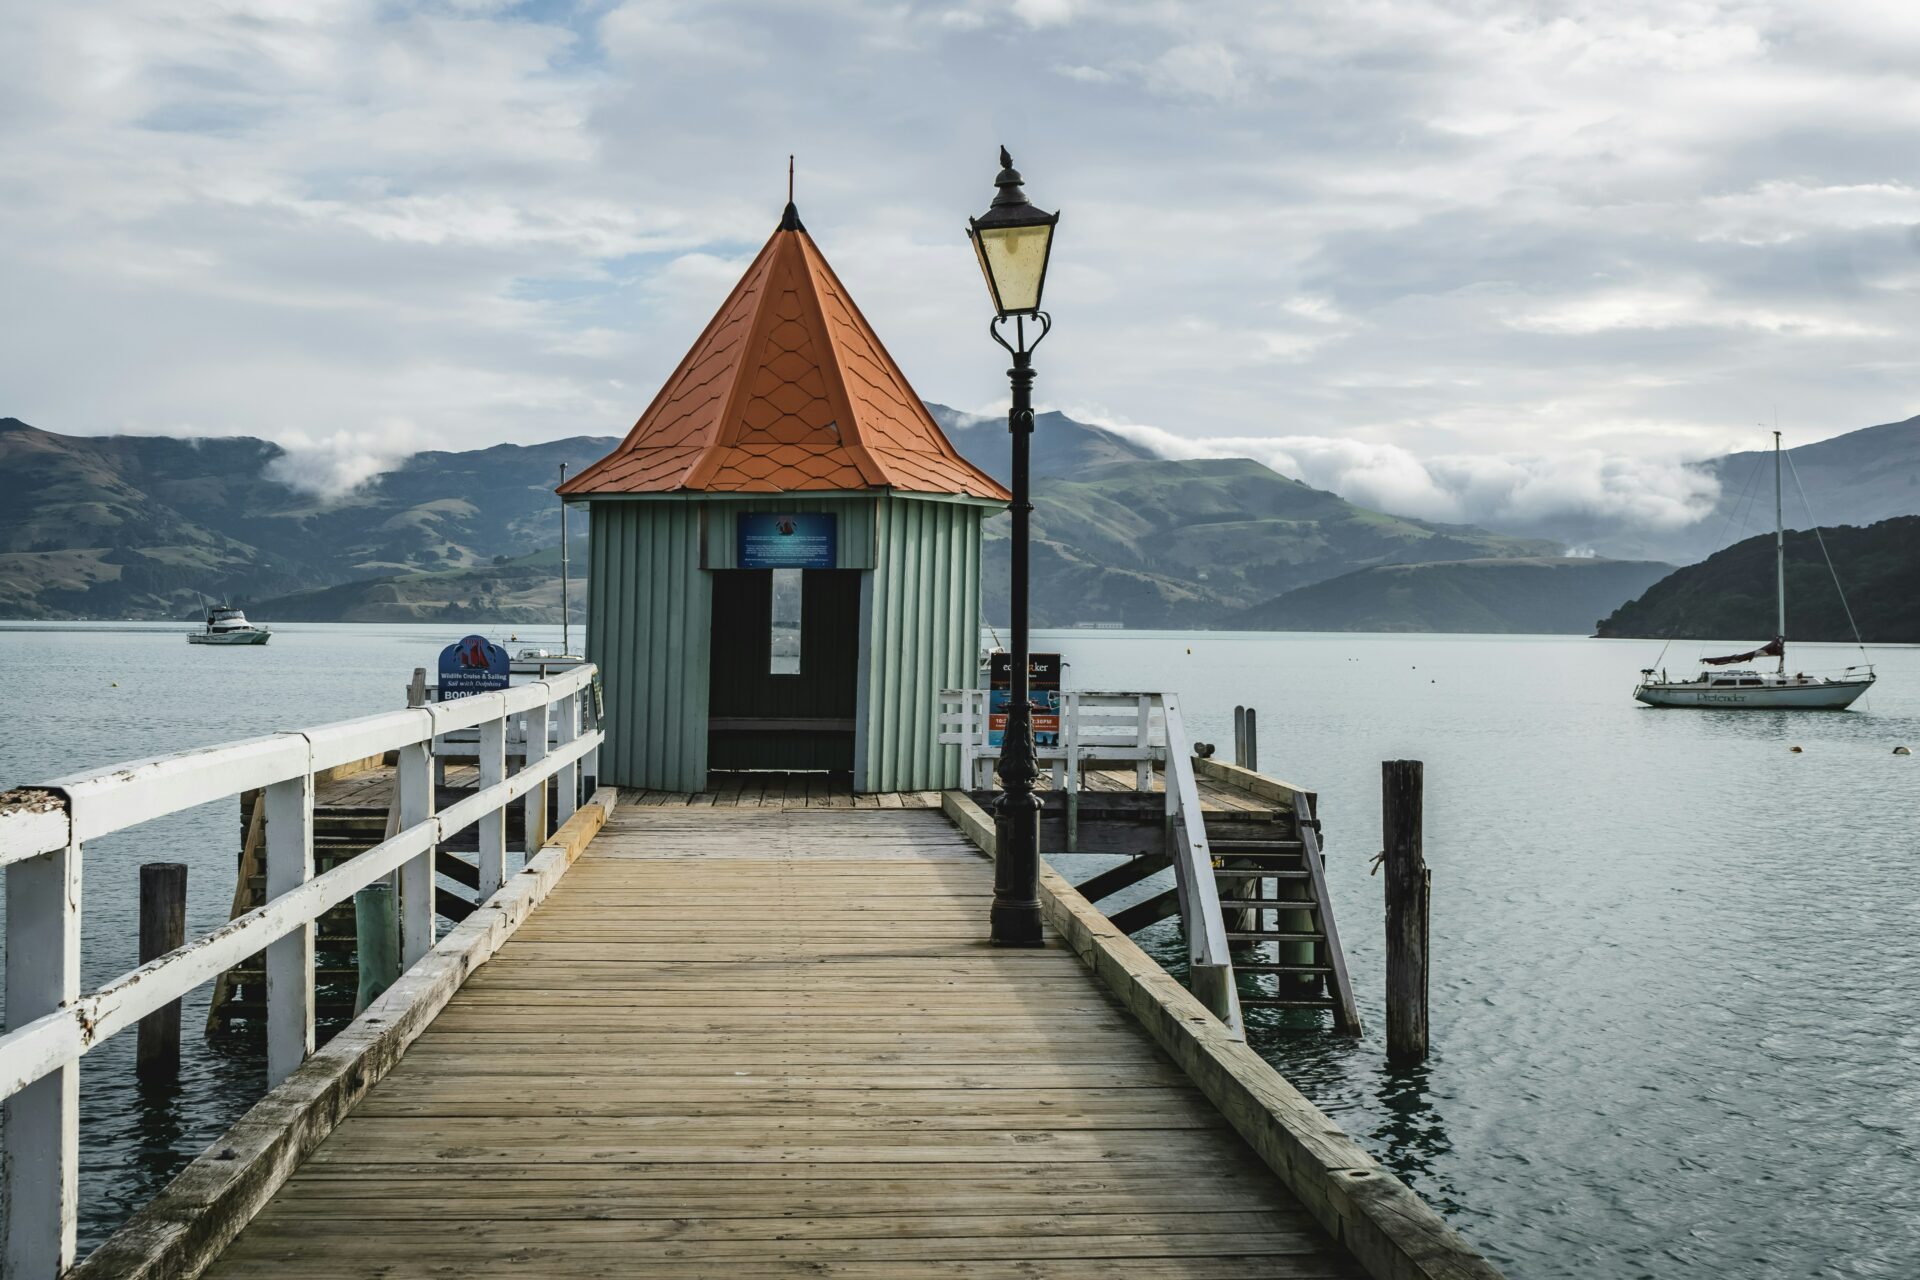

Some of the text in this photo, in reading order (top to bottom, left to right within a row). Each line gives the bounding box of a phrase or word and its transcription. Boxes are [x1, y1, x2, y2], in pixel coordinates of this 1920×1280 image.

[487, 673, 507, 681] Sailing
[444, 691, 473, 700] BOOK
[1697, 693, 1747, 701] Pretender
